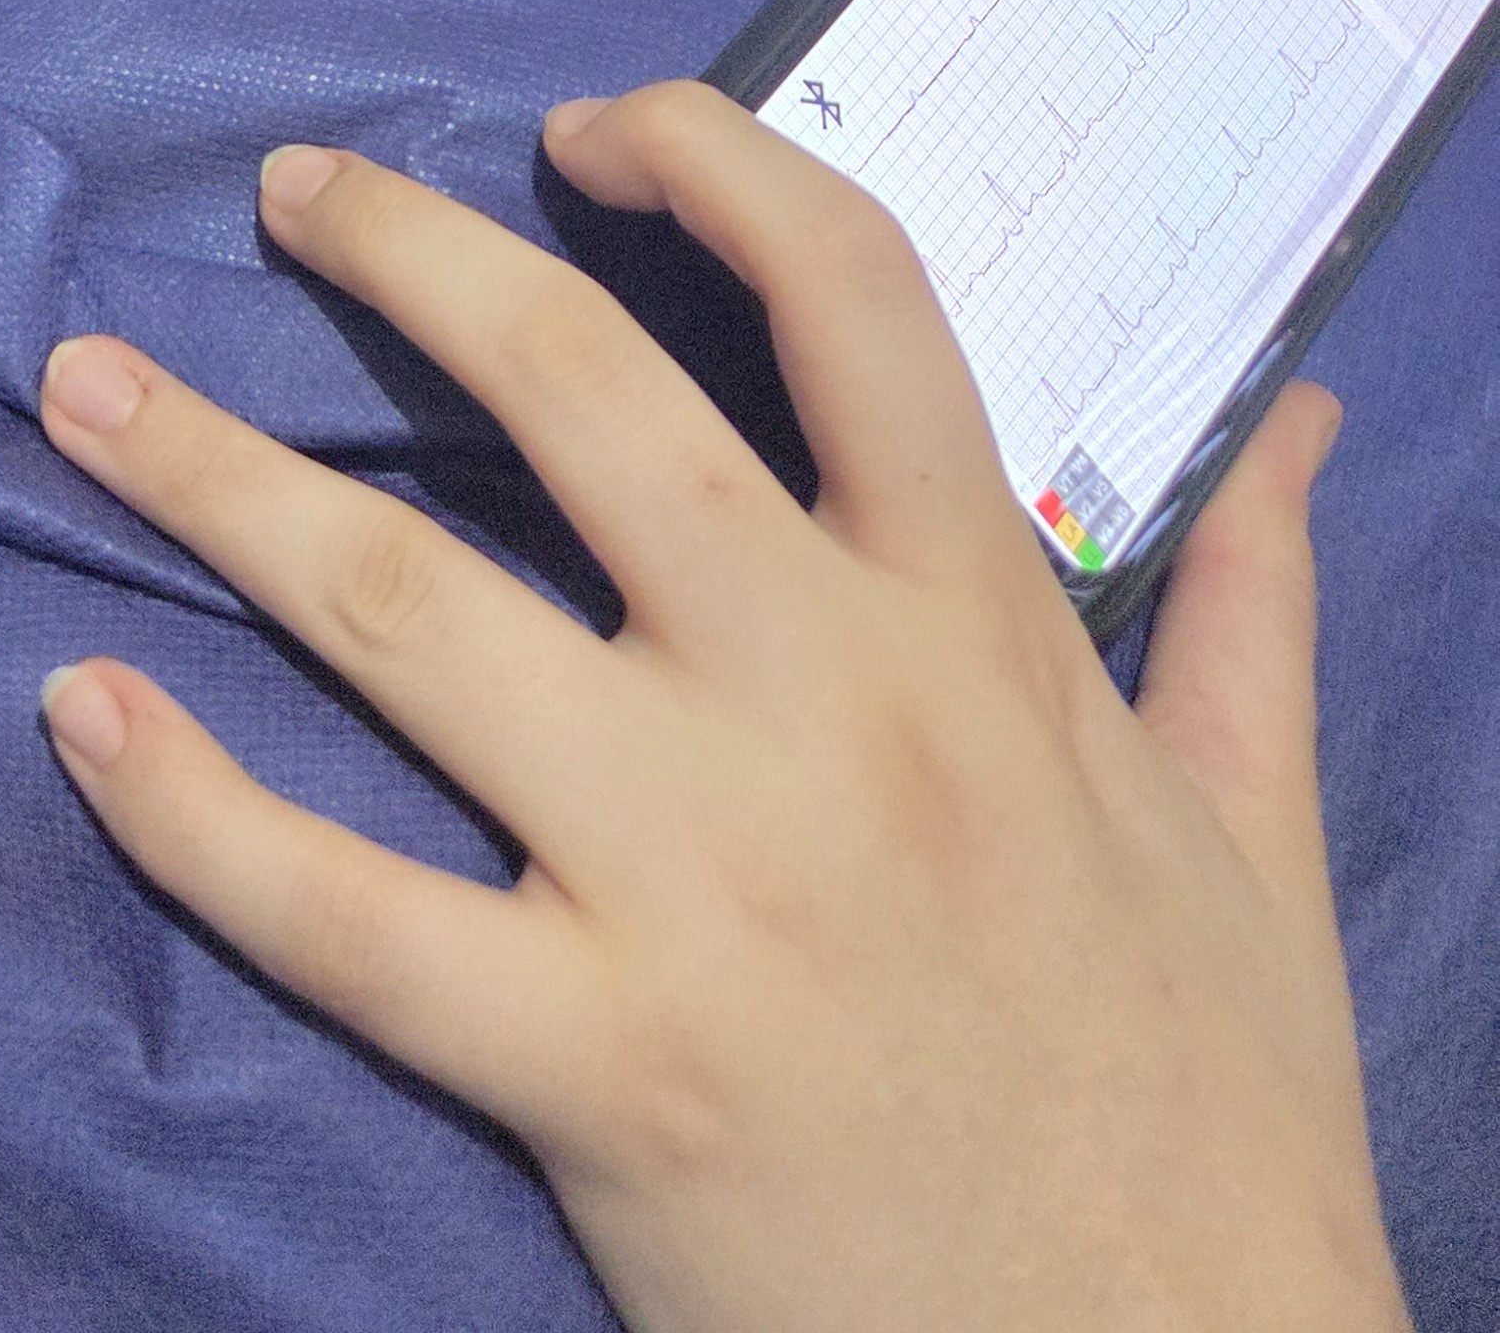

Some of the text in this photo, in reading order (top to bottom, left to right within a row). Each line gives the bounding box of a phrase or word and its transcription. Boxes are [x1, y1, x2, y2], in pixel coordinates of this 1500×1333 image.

[1057, 473, 1075, 494] V1
[1078, 498, 1094, 519] V2
[1090, 478, 1110, 498] V5
